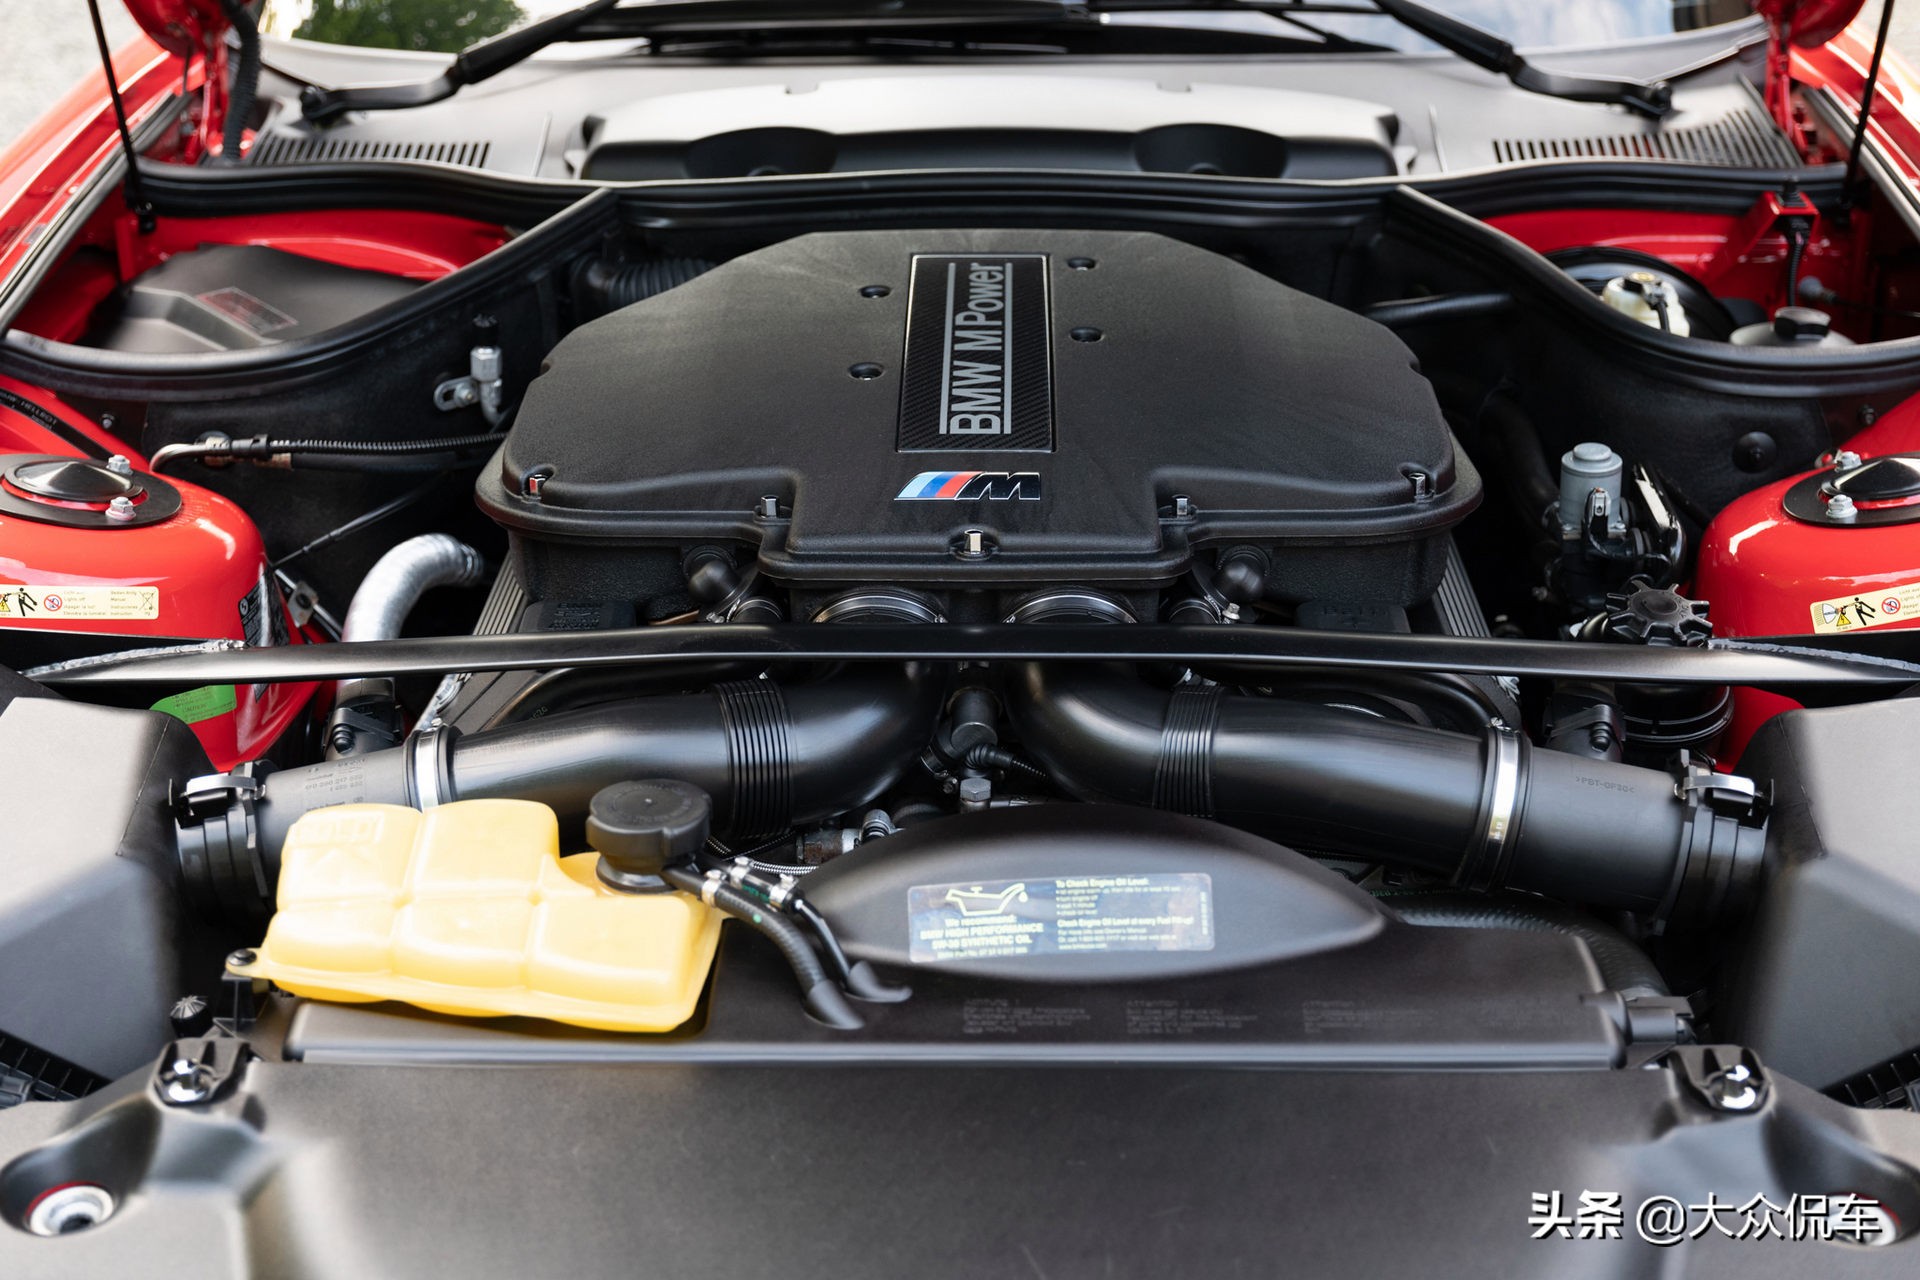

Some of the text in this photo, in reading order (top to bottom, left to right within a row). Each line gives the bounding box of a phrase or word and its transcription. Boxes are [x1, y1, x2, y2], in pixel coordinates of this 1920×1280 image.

[949, 361, 1003, 435] BMW
[954, 470, 1041, 501] M
[1066, 878, 1089, 888] Check
[1090, 878, 1115, 888] Engine
